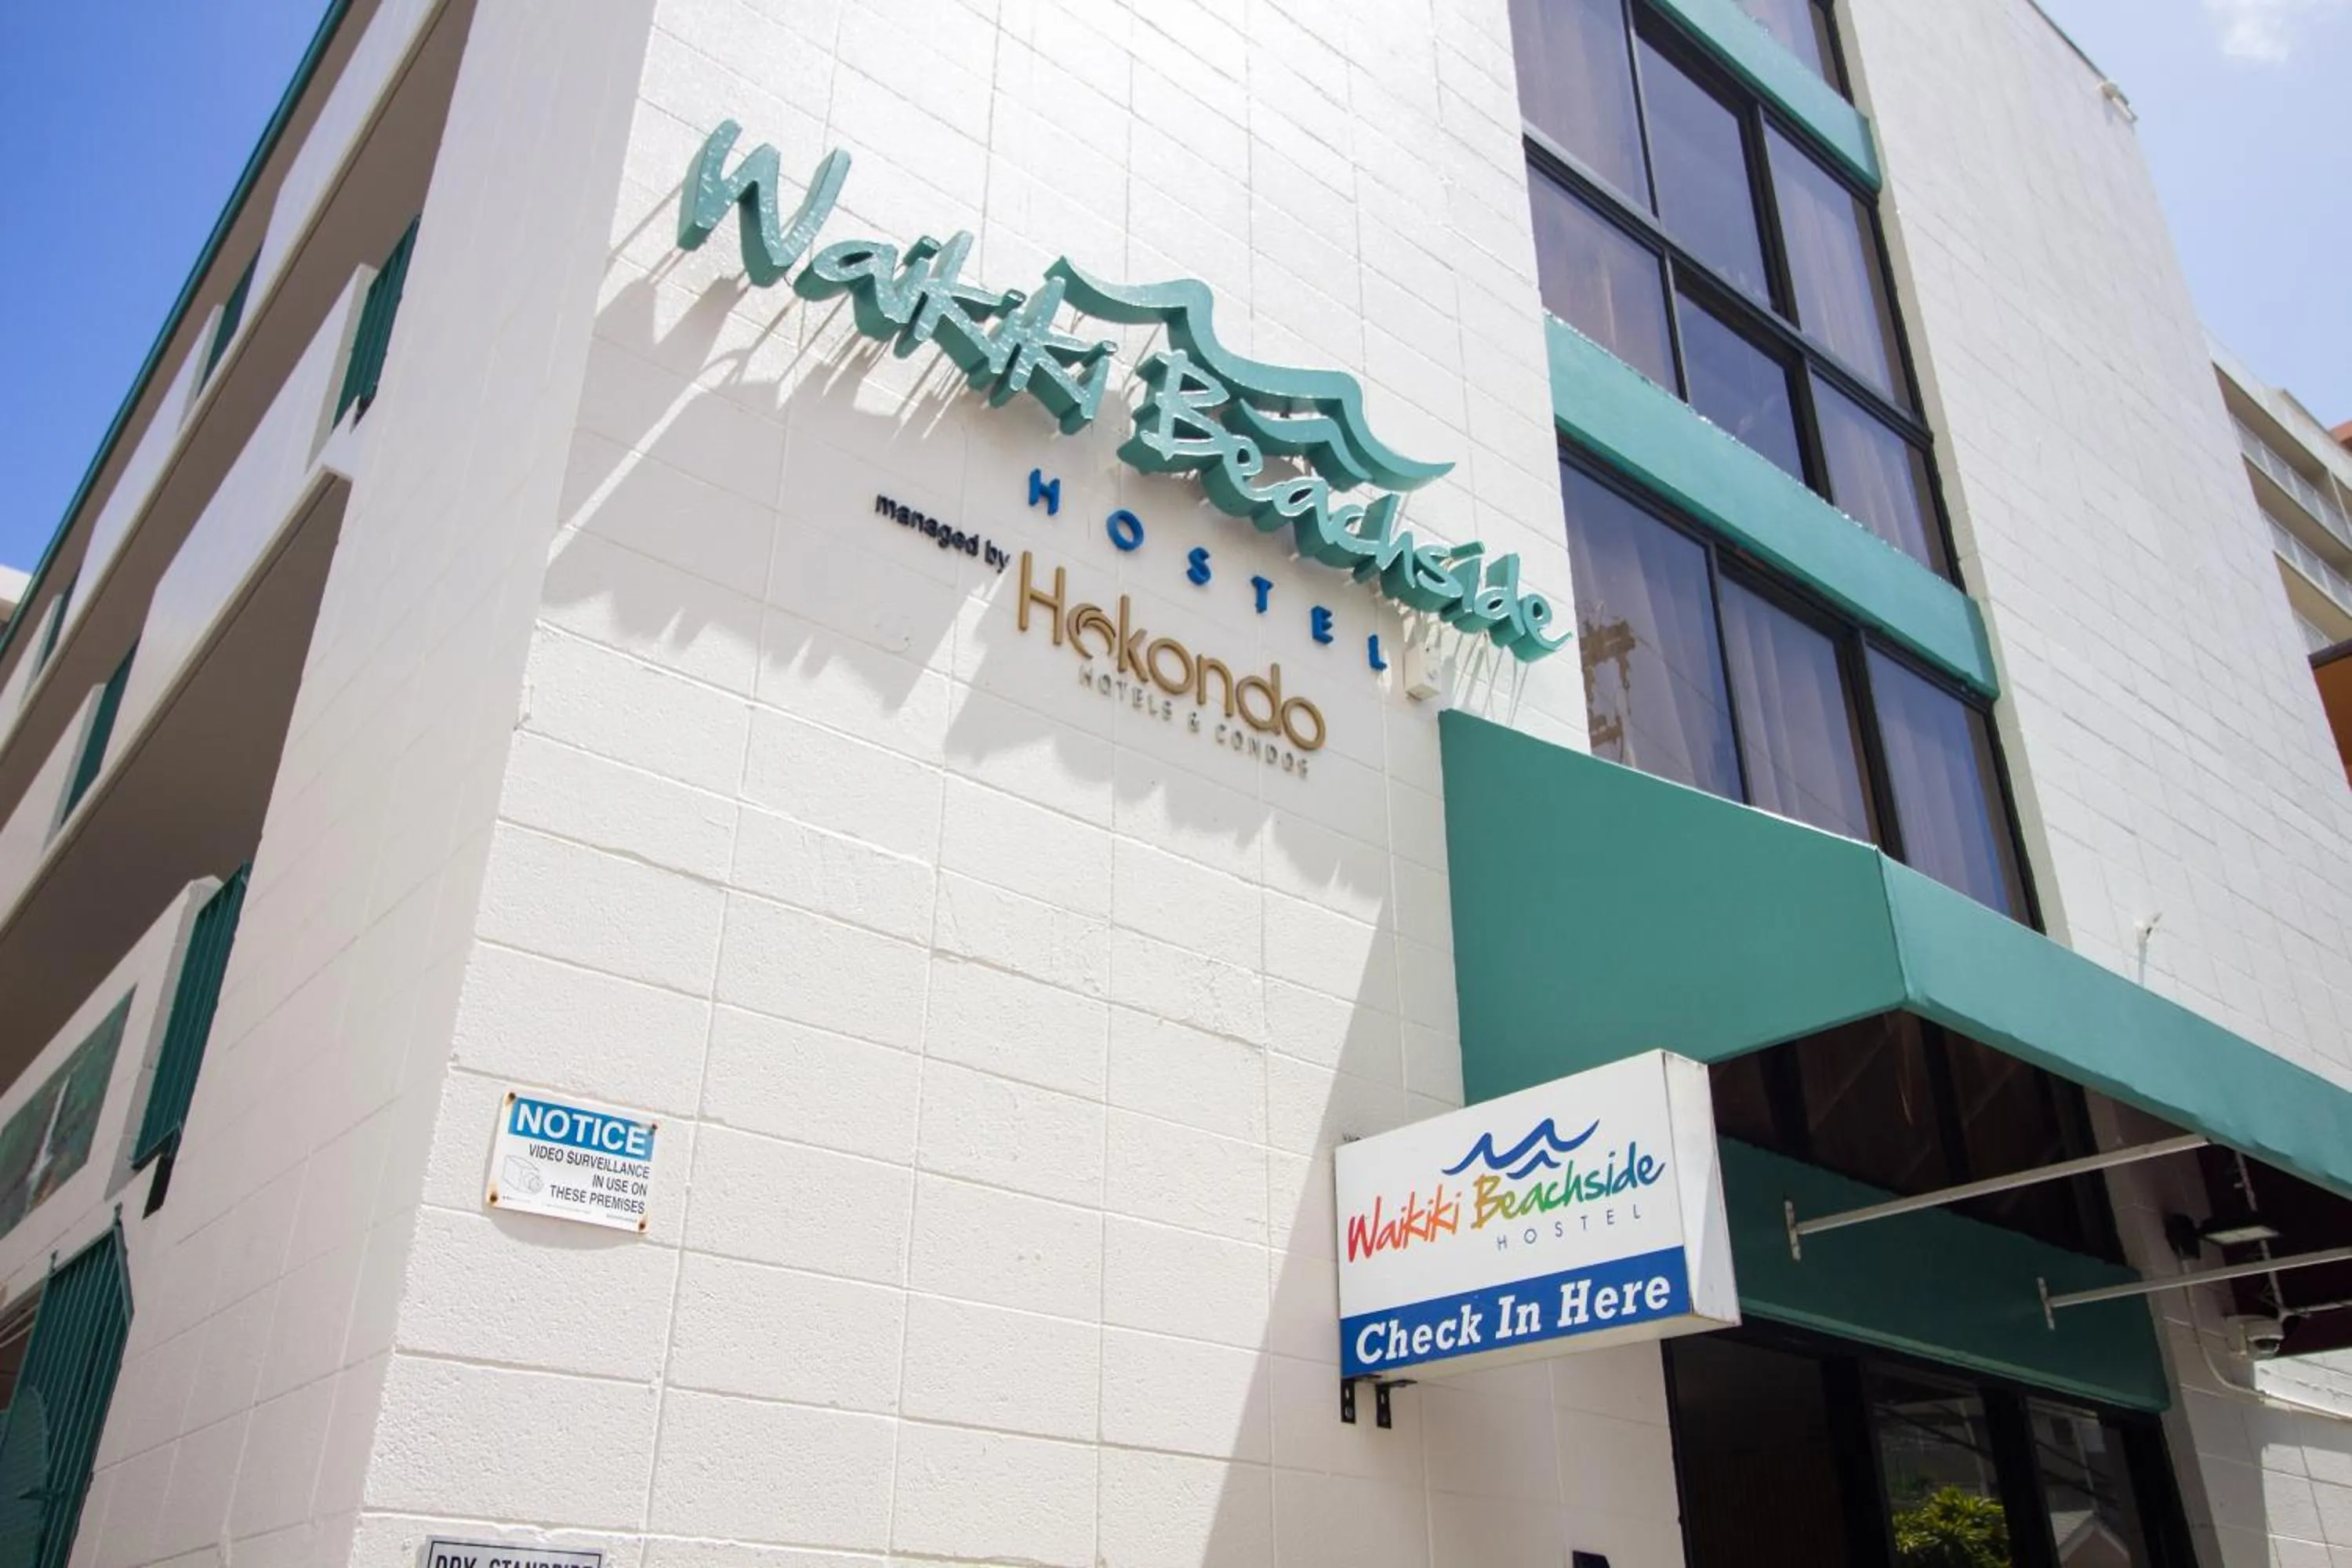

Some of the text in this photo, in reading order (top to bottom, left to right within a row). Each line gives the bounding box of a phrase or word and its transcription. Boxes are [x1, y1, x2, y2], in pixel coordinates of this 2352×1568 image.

[677, 118, 1573, 662] Waikiki Beachside
[875, 494, 1010, 574] managed by
[1028, 468, 1387, 671] HOSTEL
[1078, 663, 1308, 779] HOTELS & CONDOS
[517, 1103, 647, 1156] NOTICE
[529, 1143, 650, 1179] VIDEO SURVEILLANCE
[550, 1185, 586, 1203] THESE
[589, 1192, 645, 1214] PREMISES
[593, 1174, 648, 1197] IN USE ON
[1348, 1142, 1666, 1262] Waikiki Beachside
[1497, 1203, 1641, 1251] HOSTEL
[1356, 1276, 1671, 1365] Check In Here
